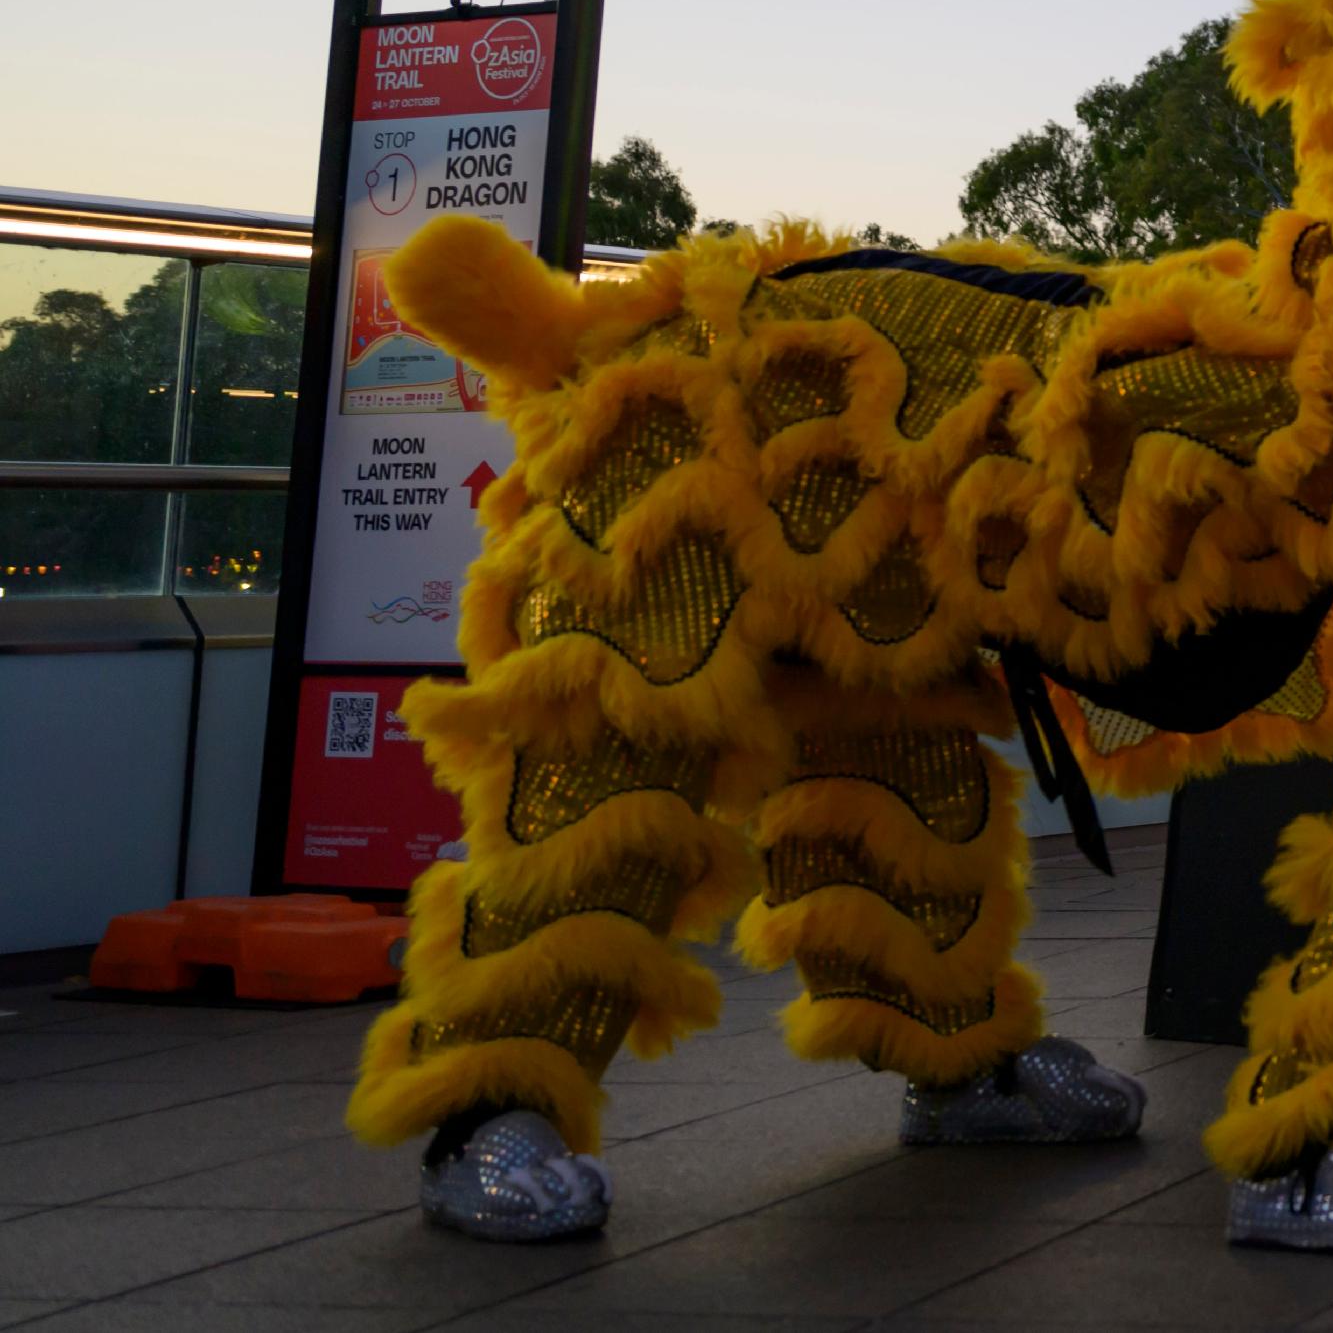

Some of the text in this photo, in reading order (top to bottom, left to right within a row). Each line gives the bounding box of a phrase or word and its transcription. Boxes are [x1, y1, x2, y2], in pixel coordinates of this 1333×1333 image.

[378, 24, 435, 47] MOON
[375, 45, 459, 69] LANTERN
[471, 39, 536, 66] OzAsia
[375, 70, 424, 91] TRAIL
[485, 65, 529, 80] Festival
[401, 96, 441, 108] OCTOBER
[374, 131, 415, 150] STOP
[447, 124, 517, 152] HONG
[445, 154, 513, 180] KONG
[388, 168, 398, 202] 1
[425, 181, 528, 209] DRAGON
[372, 438, 425, 455] MOON
[357, 462, 436, 481] LANTERN
[342, 487, 449, 506] TRAIL ENTRY
[354, 513, 432, 531] THIS WAY
